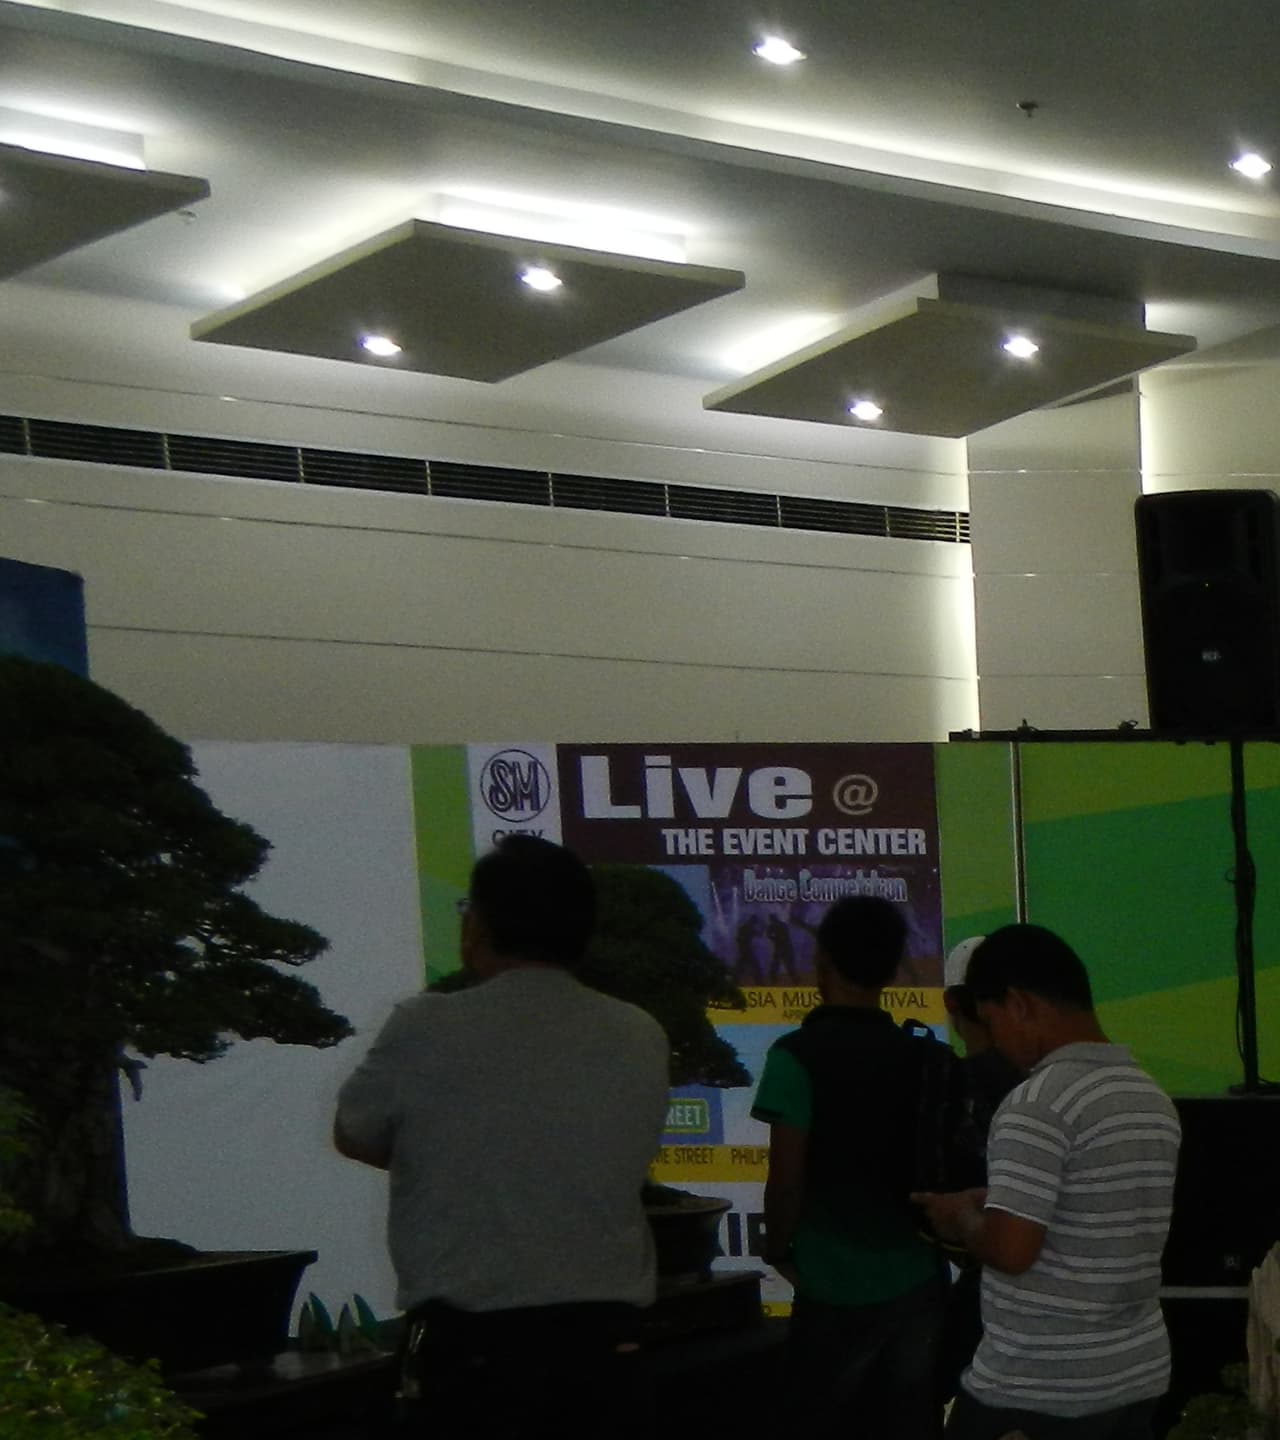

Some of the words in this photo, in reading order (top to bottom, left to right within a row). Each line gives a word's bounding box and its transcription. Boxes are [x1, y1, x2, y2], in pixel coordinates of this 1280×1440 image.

[489, 759, 539, 811] SM
[579, 754, 813, 820] Live
[833, 773, 879, 816] @
[661, 827, 714, 856] THE
[721, 827, 808, 856] EVENT
[818, 827, 928, 856] CENTER
[743, 867, 796, 902] Dance
[674, 1147, 713, 1165] STREET
